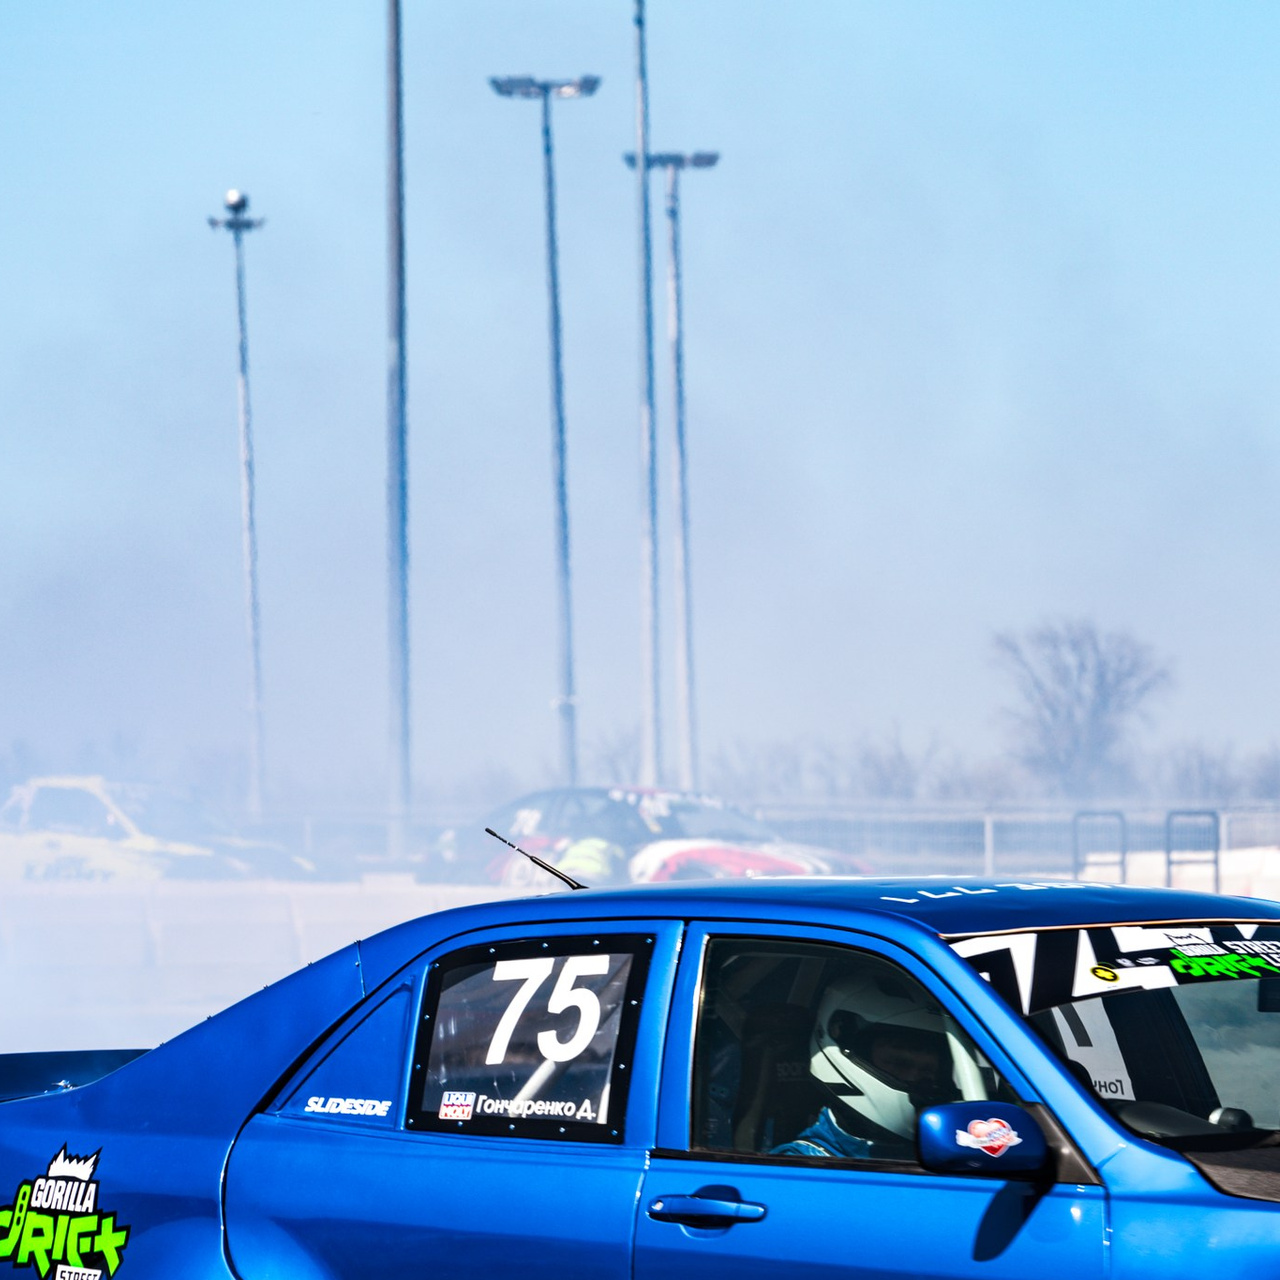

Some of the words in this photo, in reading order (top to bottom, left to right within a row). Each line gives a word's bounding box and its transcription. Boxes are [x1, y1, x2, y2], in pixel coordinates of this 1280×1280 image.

[485, 954, 610, 1065] 75
[304, 1096, 392, 1117] SLIDESIDE
[476, 1094, 576, 1119] Гончаренко
[31, 1177, 97, 1213] GORILLA
